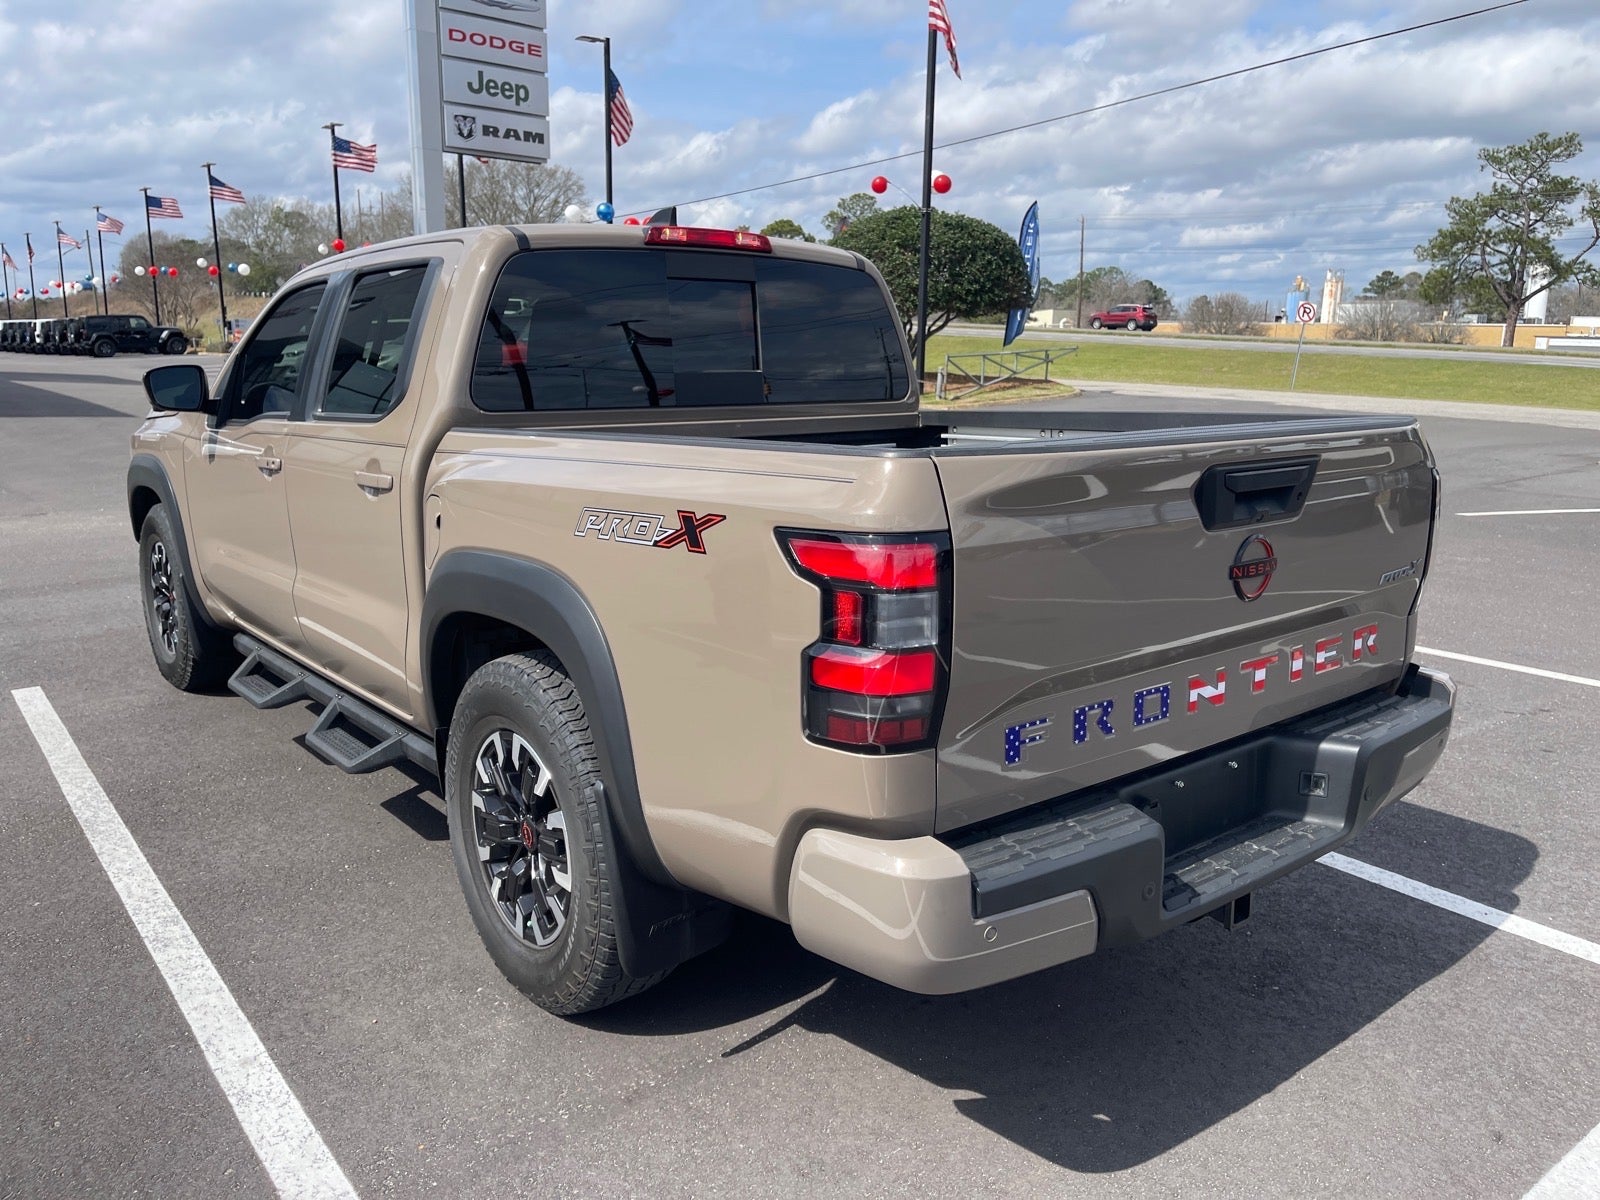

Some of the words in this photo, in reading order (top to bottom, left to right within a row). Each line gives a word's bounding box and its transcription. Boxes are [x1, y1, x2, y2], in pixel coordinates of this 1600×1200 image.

[448, 28, 543, 57] DODGE
[467, 70, 530, 106] Jeep
[482, 124, 545, 145] RAM
[1232, 559, 1278, 578] NISSAN
[1005, 623, 1379, 767] FRONTIER
